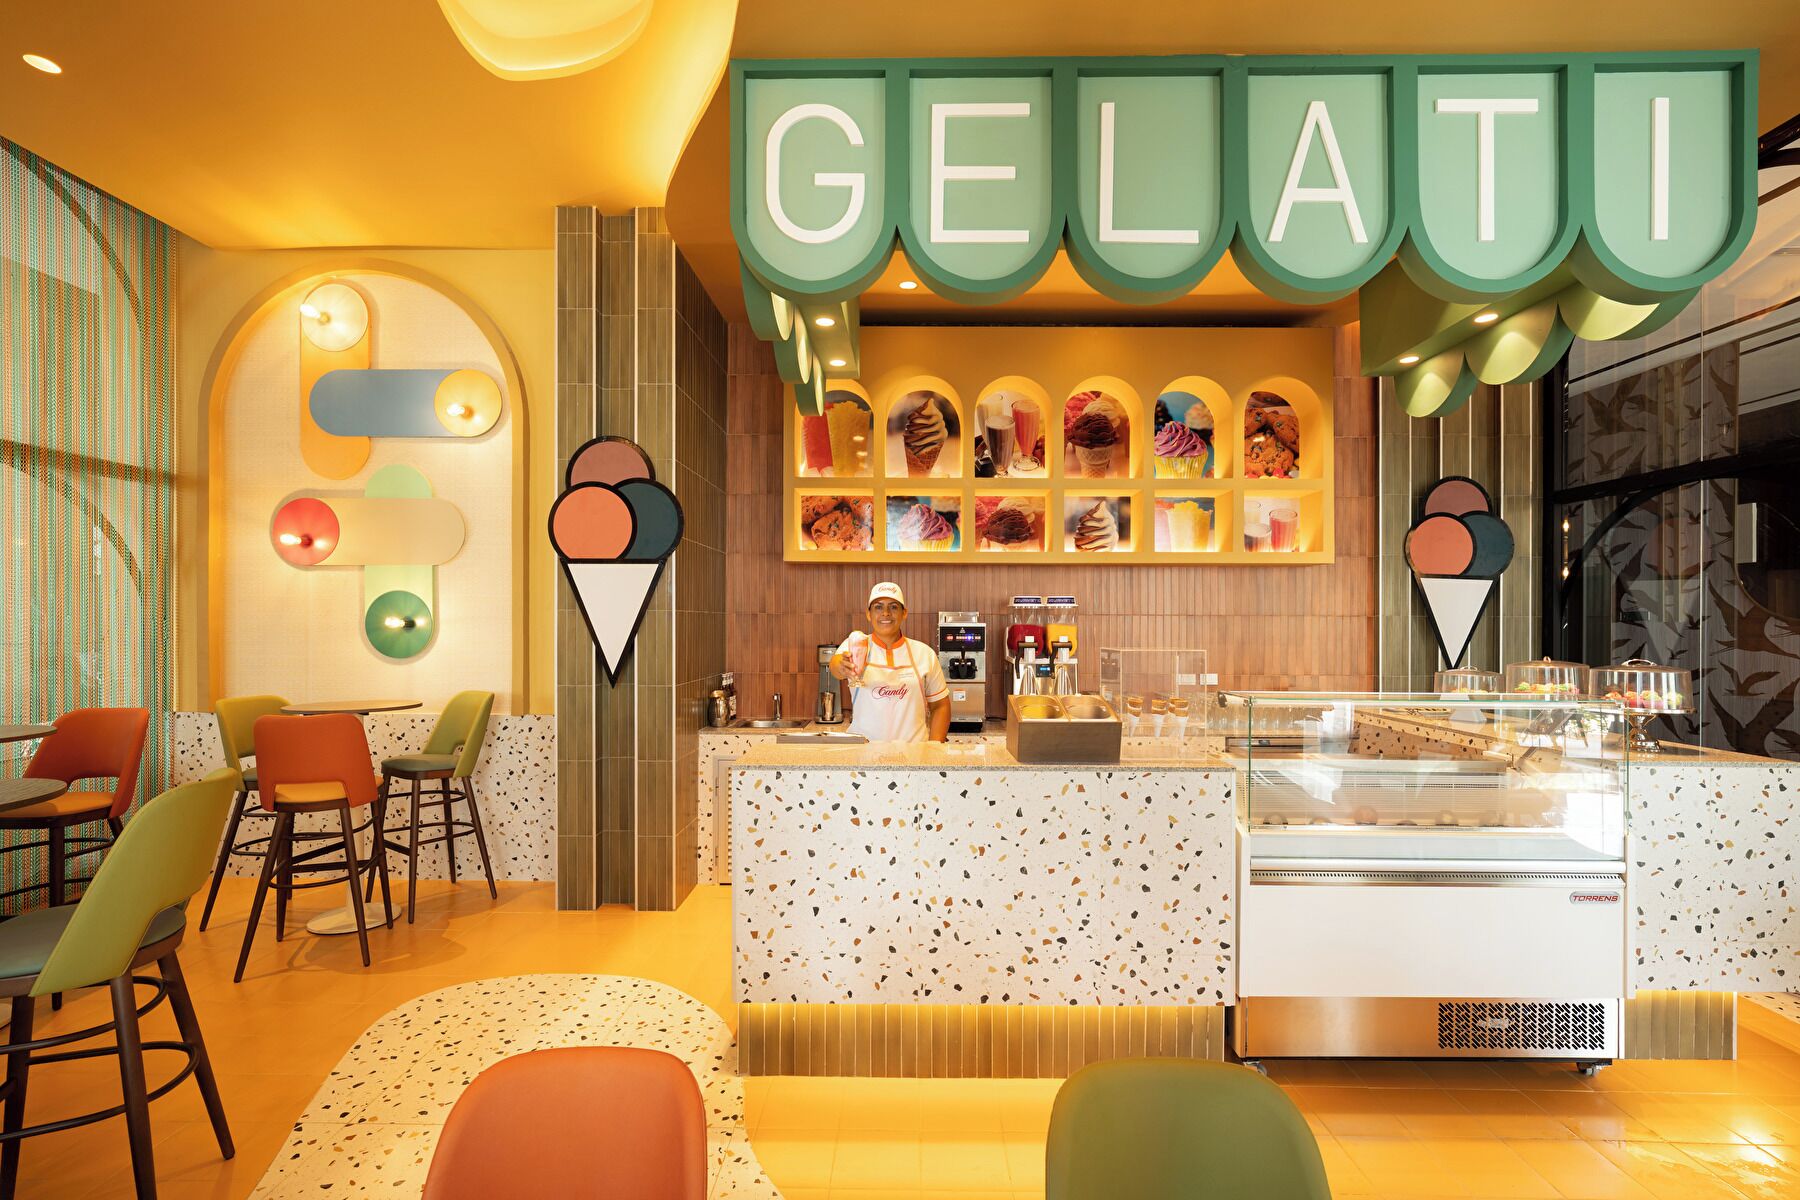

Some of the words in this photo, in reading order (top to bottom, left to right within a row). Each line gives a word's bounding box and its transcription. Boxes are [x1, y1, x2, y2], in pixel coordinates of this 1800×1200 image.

[765, 97, 1669, 245] GELATI
[878, 585, 897, 594] Candy
[872, 683, 909, 700] Candy
